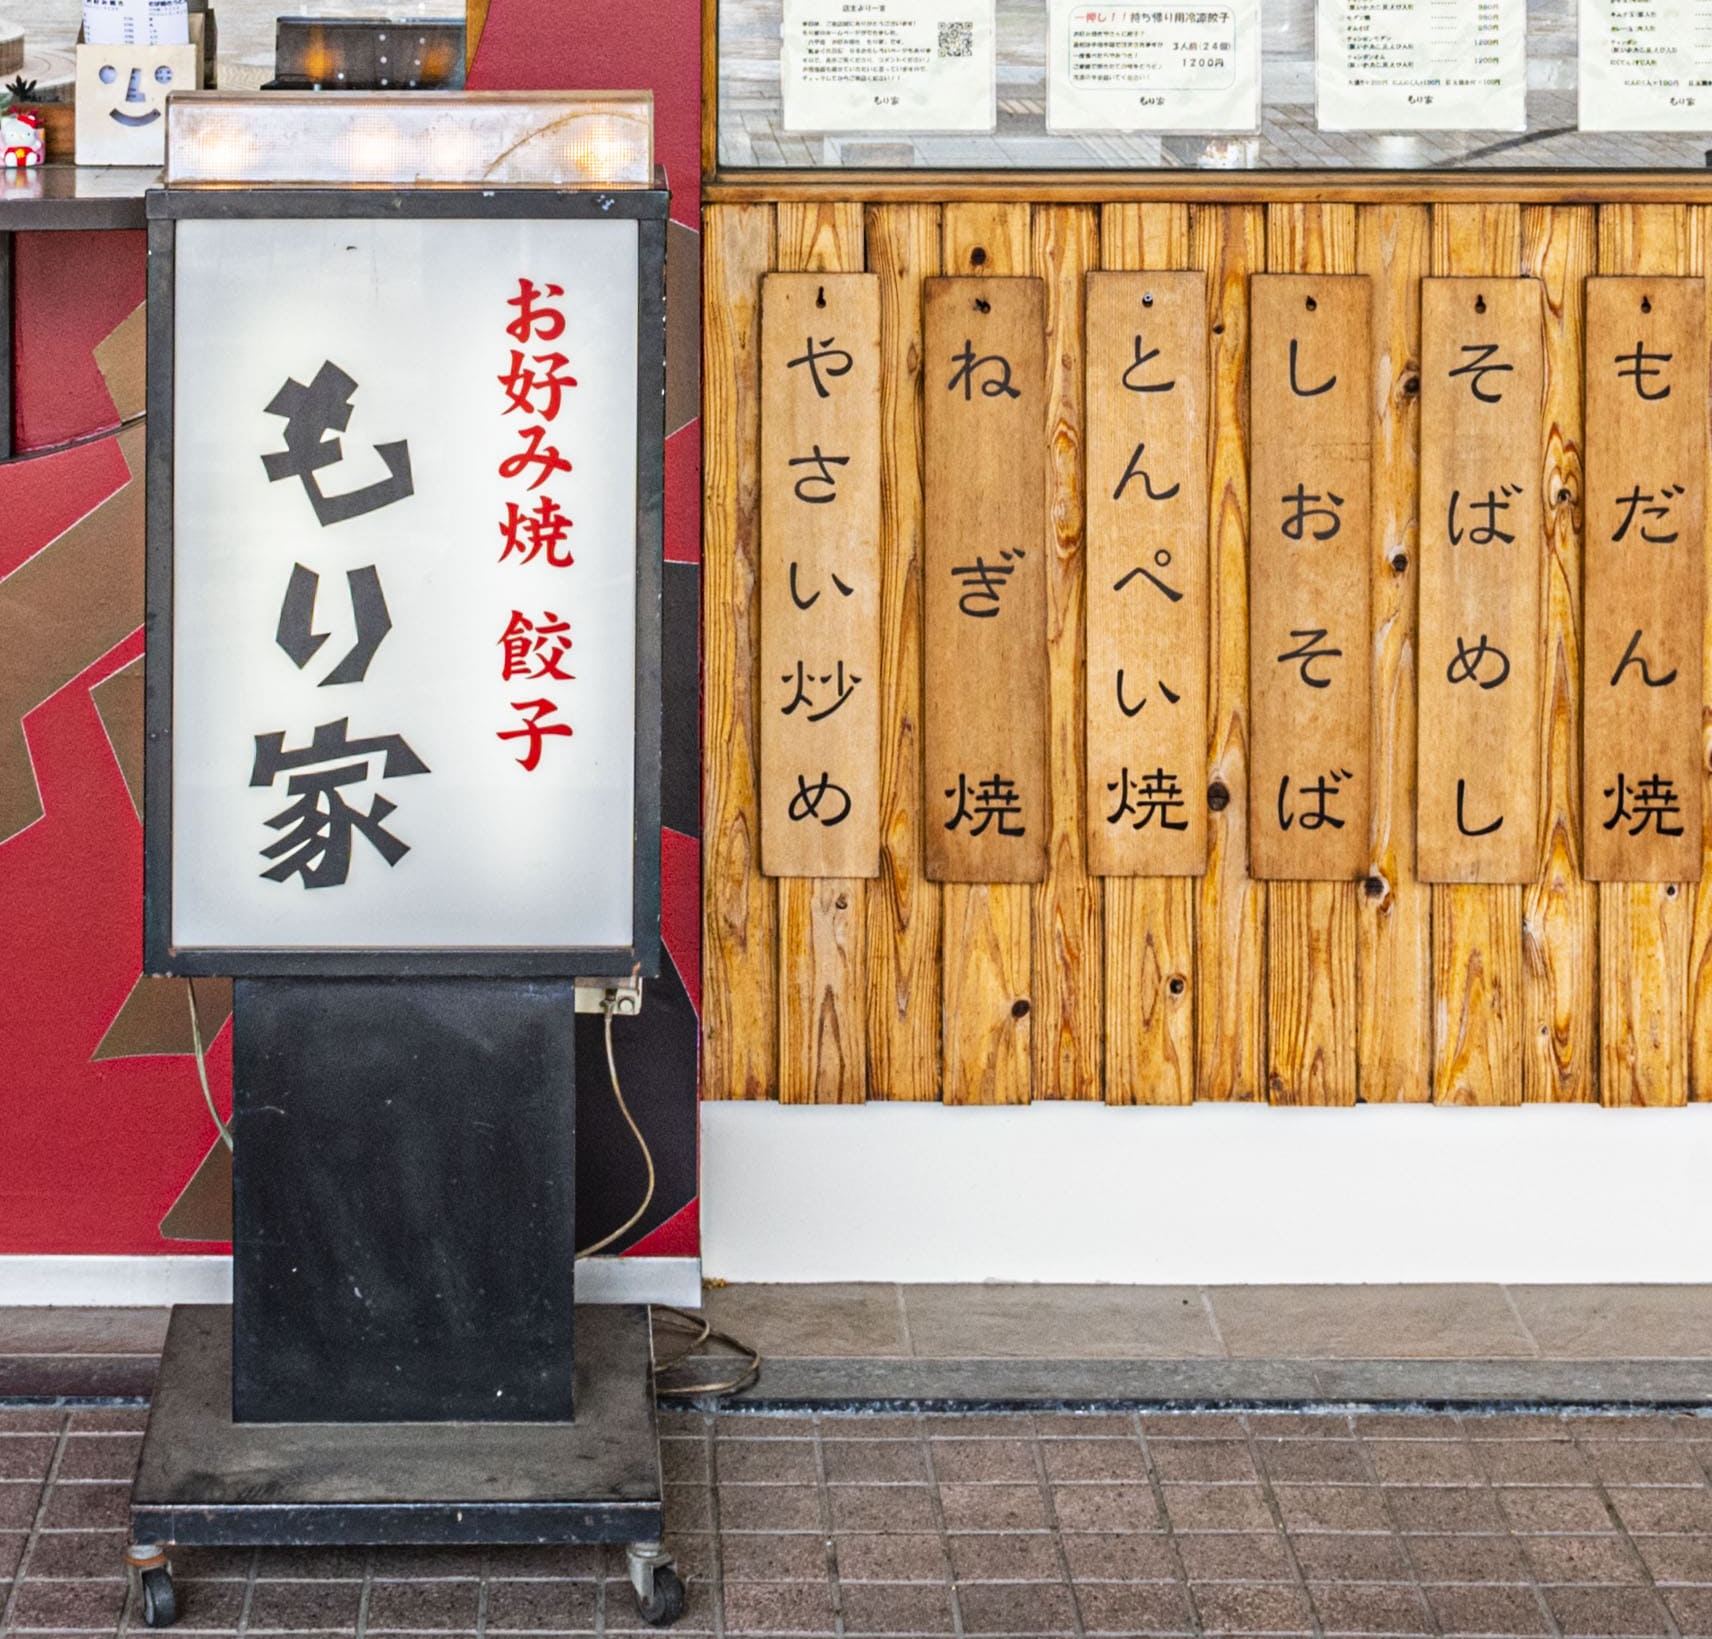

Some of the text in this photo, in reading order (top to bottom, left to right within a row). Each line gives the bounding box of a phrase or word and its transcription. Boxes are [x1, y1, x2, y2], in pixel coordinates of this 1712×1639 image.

[872, 95, 900, 106] もり家
[1138, 96, 1166, 106] もり家
[1180, 57, 1225, 68] 1200円
[1406, 95, 1434, 105] もり家
[1668, 96, 1697, 107] もり家
[248, 359, 432, 891] もり家
[496, 277, 578, 772] お好み焼 餃子
[780, 336, 862, 829] やさい炒め
[944, 339, 1027, 838] ねぎ焼
[1106, 335, 1190, 832] とんぺい焼
[1276, 338, 1353, 833] しおそば
[1446, 343, 1524, 837] そばめし
[1600, 341, 1685, 837] もだん焼
